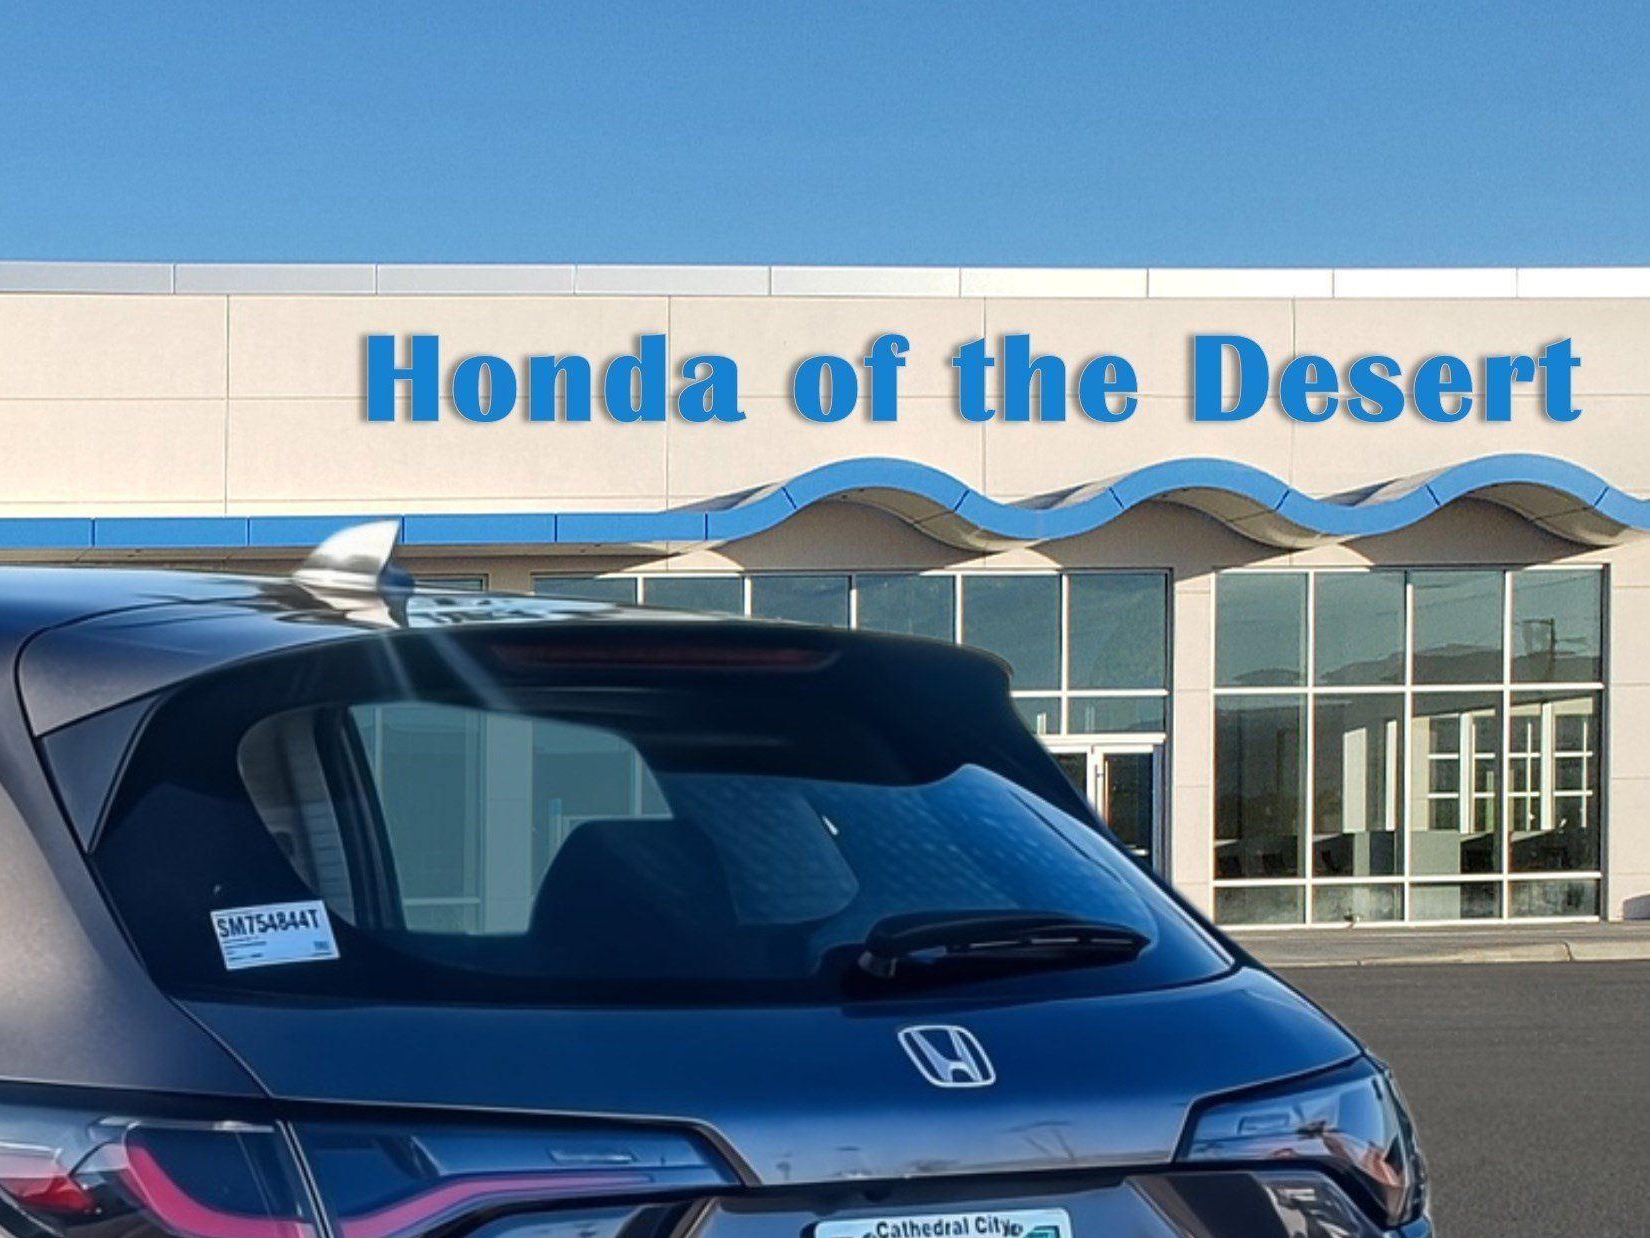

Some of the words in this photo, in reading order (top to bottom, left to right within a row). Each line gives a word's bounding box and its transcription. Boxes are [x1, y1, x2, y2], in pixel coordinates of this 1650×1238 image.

[366, 334, 747, 422] Honda
[794, 334, 911, 422] of
[952, 334, 1139, 422] the
[1194, 334, 1583, 422] Desert
[974, 1215, 1011, 1238] City
